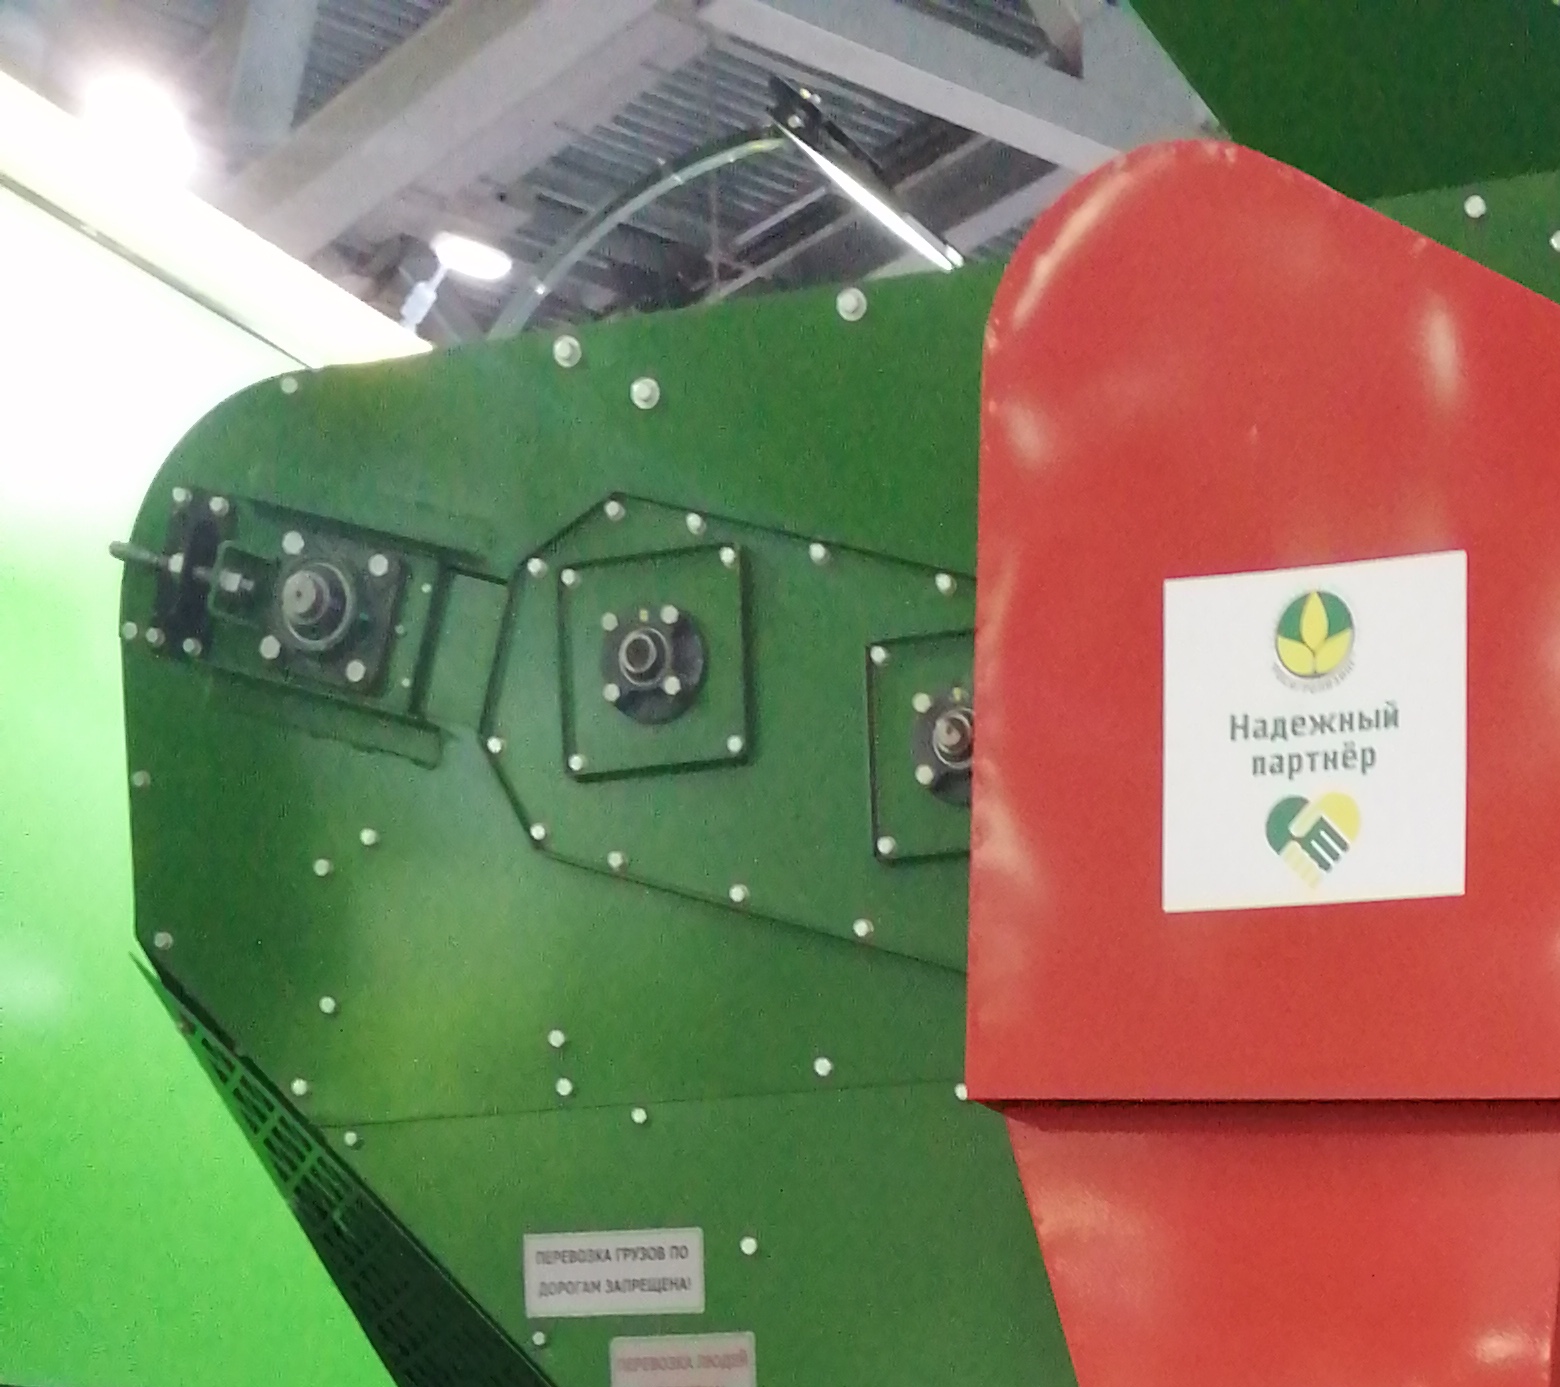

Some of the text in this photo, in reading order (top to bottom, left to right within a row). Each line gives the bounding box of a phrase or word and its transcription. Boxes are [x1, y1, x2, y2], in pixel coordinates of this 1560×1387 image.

[1229, 700, 1399, 742] Надежный
[1252, 741, 1377, 780] партнёр
[535, 1245, 689, 1265] ПЕРЕВОЗКА ГРУЗОВ ПО
[538, 1277, 692, 1298] ДОРОГАМ ЗАПРЕЩЕНА!
